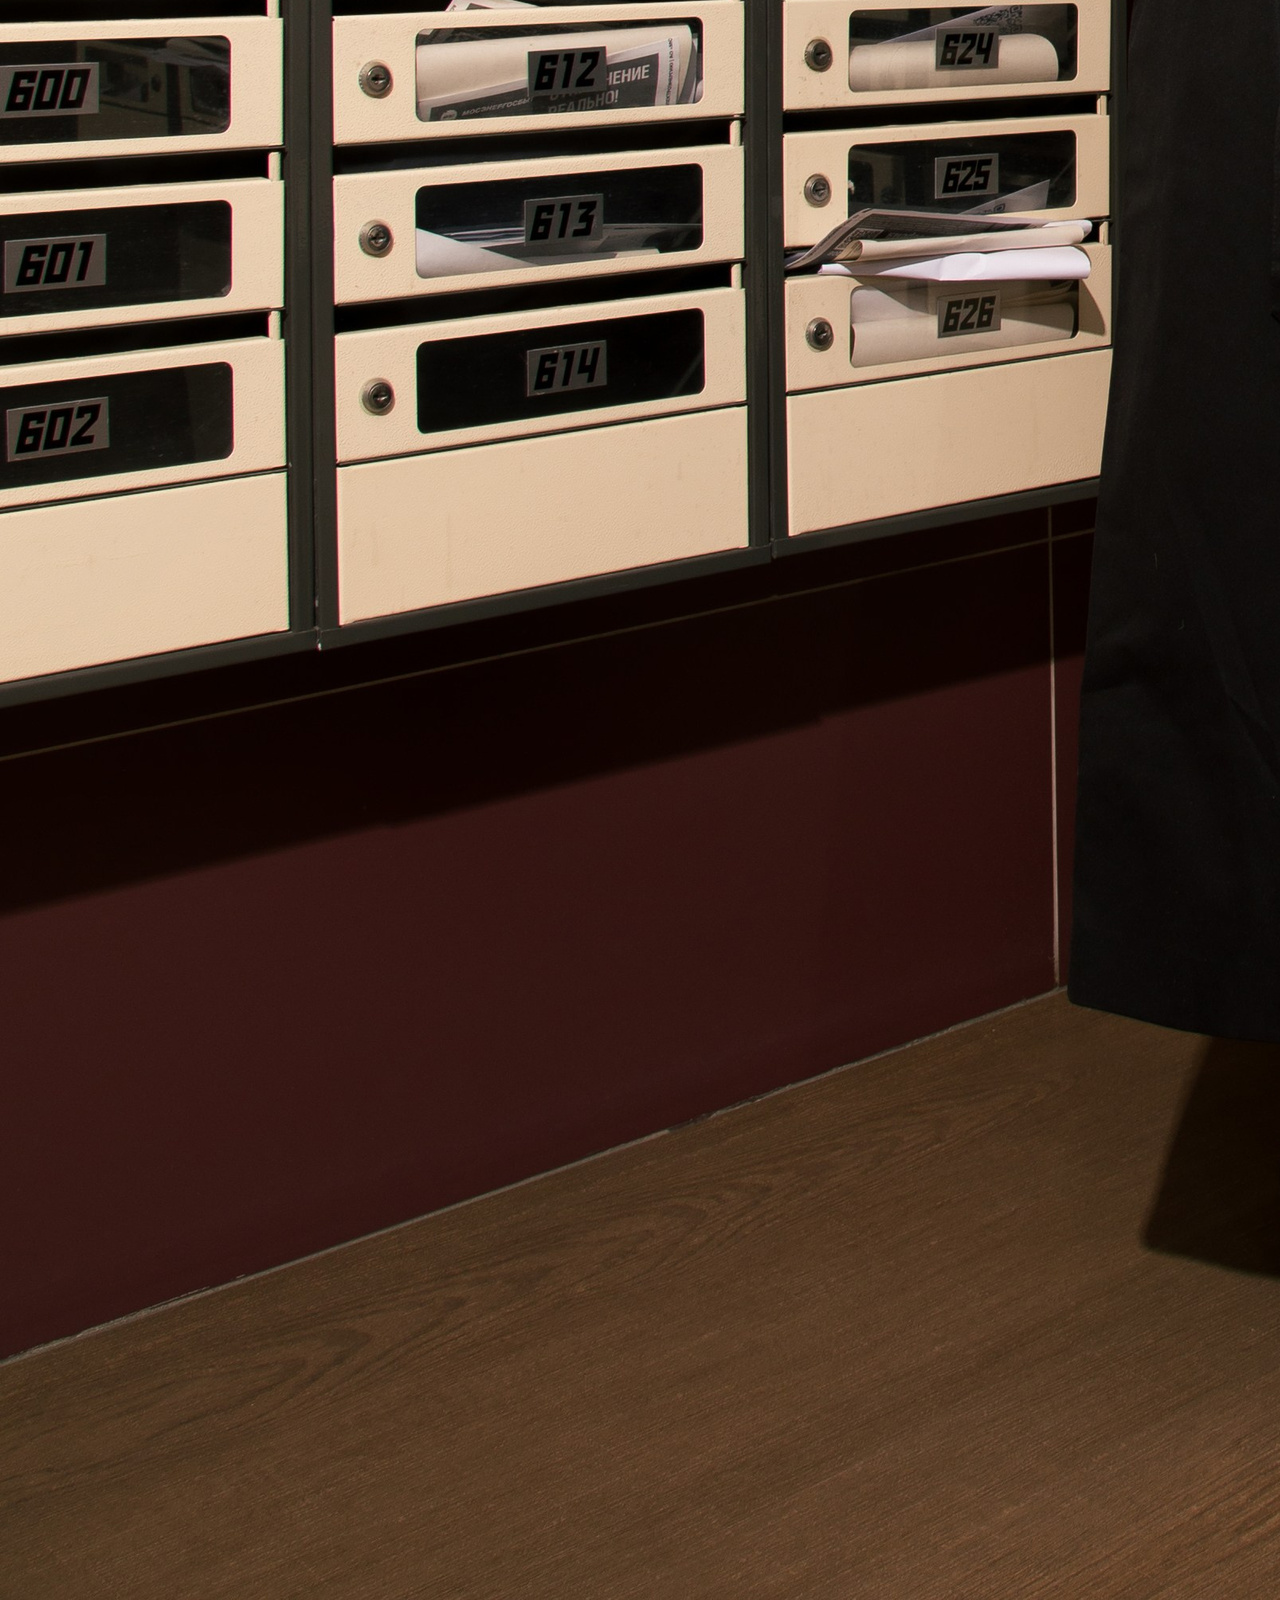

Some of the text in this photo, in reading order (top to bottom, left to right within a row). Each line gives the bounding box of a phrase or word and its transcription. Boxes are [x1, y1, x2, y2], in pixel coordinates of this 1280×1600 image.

[940, 32, 994, 65] 624
[5, 69, 91, 112] 600
[534, 51, 600, 91] 612
[942, 158, 993, 193] 625
[530, 200, 597, 241] 613
[16, 241, 94, 286] 601
[942, 295, 996, 333] 626
[534, 347, 600, 391] 614
[15, 404, 101, 454] 602
